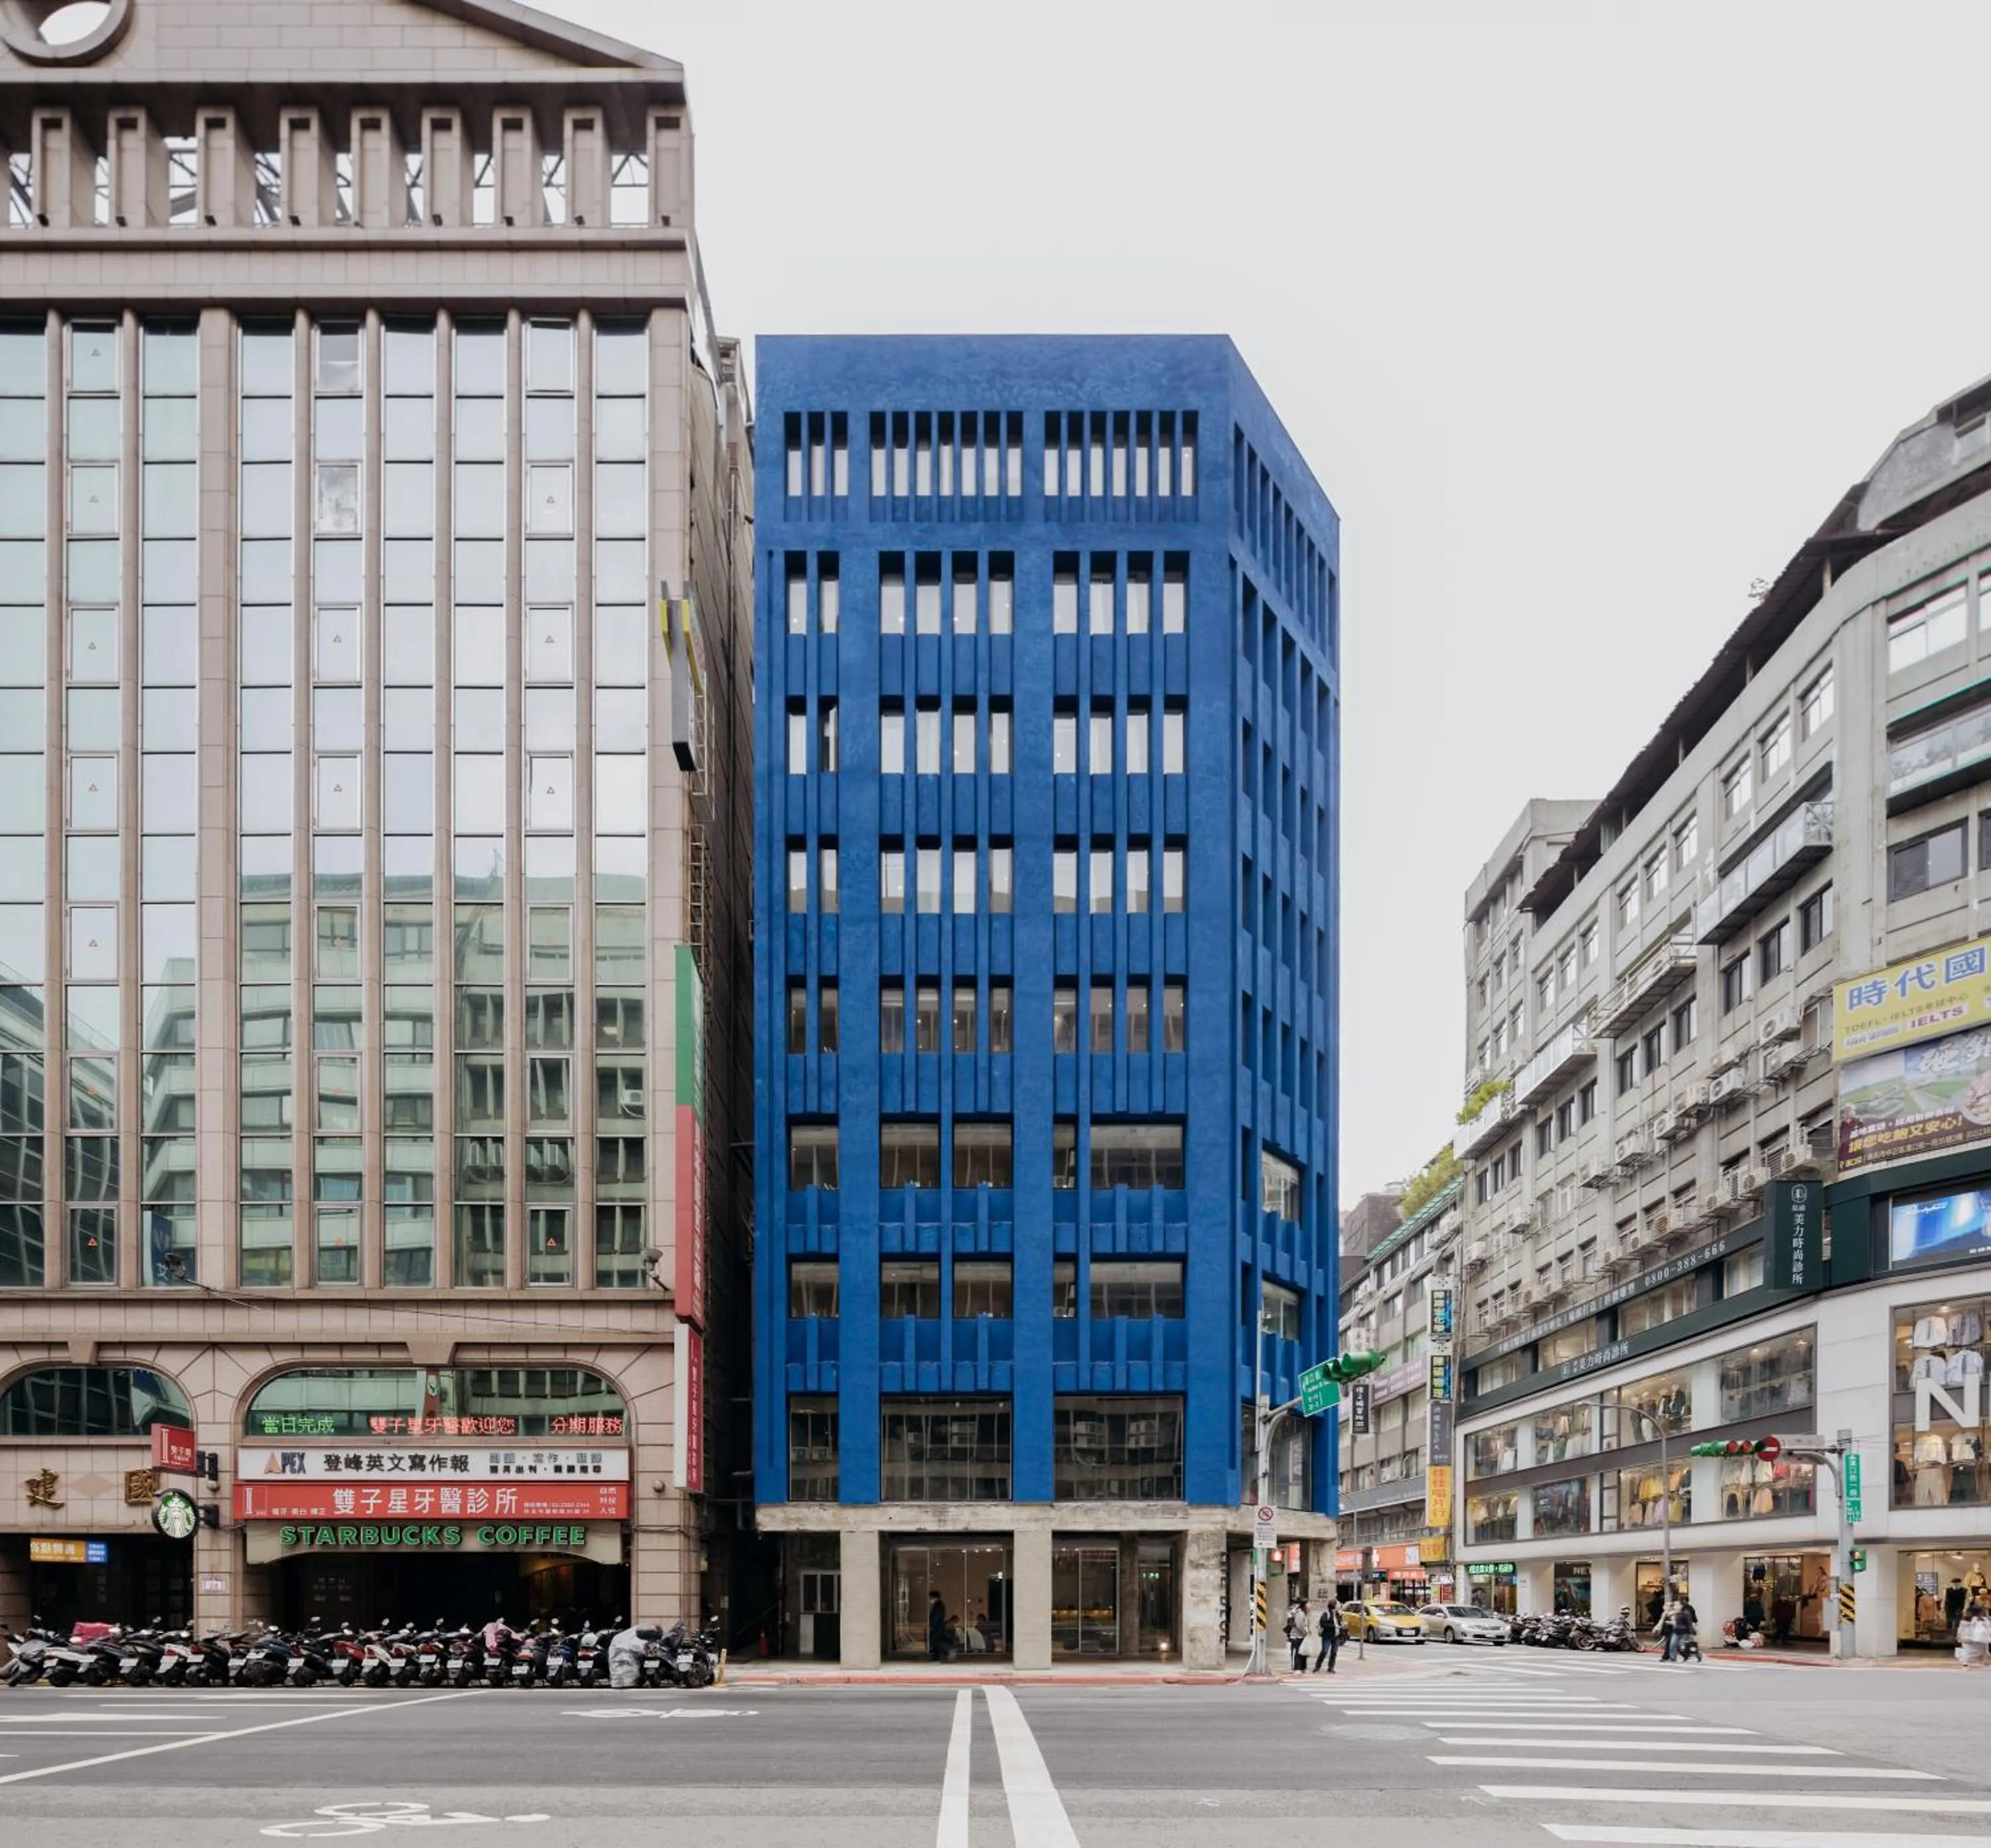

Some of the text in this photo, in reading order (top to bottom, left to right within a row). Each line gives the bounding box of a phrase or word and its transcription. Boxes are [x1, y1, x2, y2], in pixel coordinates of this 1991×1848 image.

[1849, 947, 1985, 1010] 時代國
[1911, 1006, 1964, 1028] IELTS
[1644, 1240, 1726, 1286] 0800-388-666
[1915, 1372, 1991, 1432] N
[261, 1416, 334, 1434] 當日完成
[550, 1416, 624, 1434] 分期服務
[323, 1453, 471, 1473] 登峰英文寫作報
[332, 1488, 518, 1515] 雙子星牙醫診所
[279, 1525, 586, 1546] STARBUCKS COFFEE
